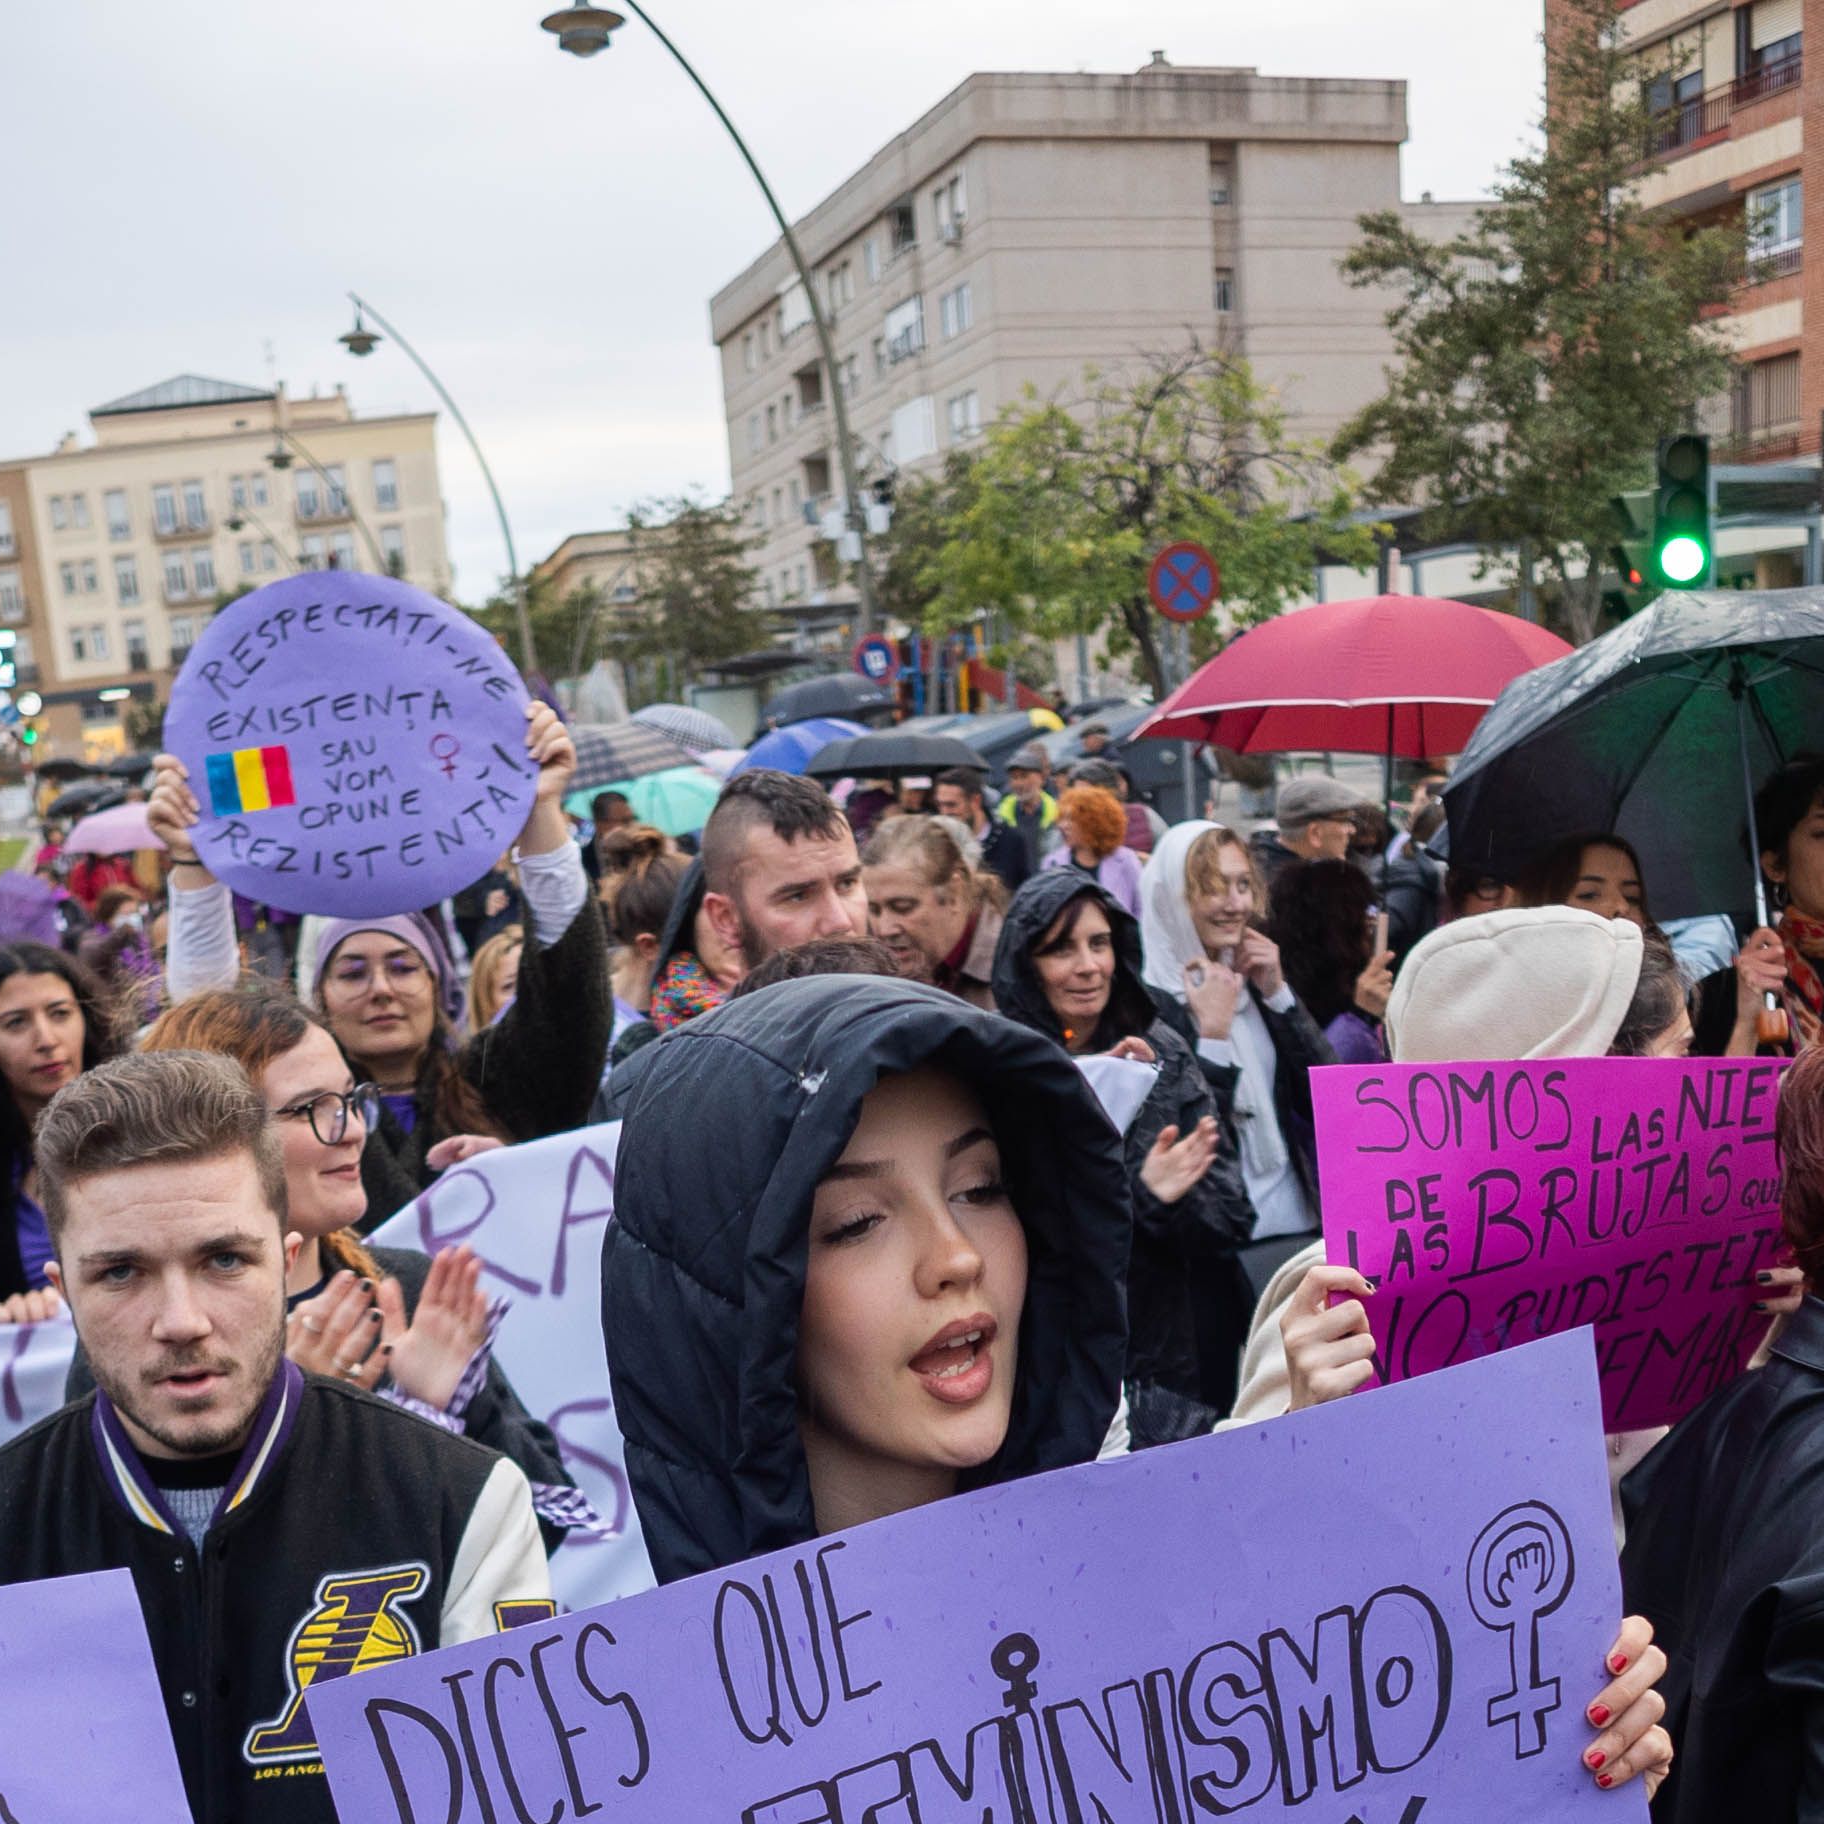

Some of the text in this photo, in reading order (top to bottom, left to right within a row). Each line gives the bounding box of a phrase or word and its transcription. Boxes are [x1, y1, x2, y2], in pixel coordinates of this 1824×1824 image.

[321, 737, 376, 768] SAU
[324, 765, 394, 794] VOM
[300, 790, 421, 830] OPUNE
[1356, 1065, 1790, 1164] SOMOS LAS NIE
[1385, 1173, 1444, 1222] DE
[1448, 1144, 1732, 1283] BRUJAS
[1347, 1223, 1451, 1285] LAS
[712, 1540, 883, 1744] QUE
[254, 1767, 282, 1780] LOS
